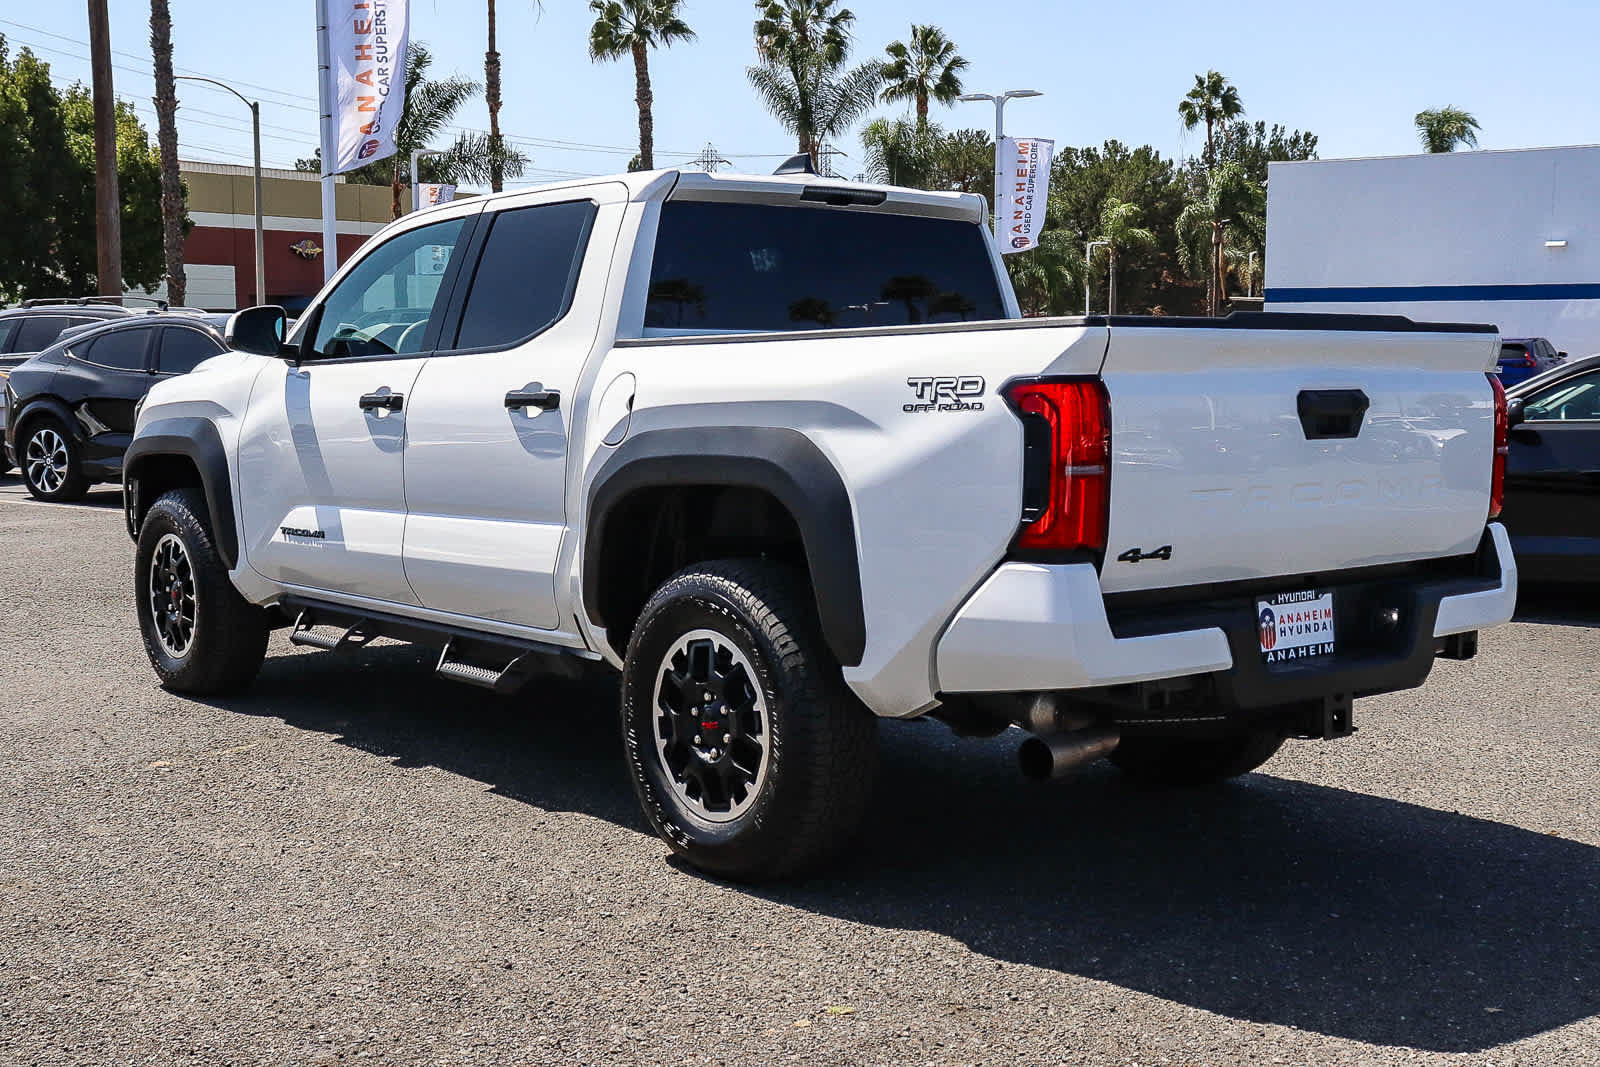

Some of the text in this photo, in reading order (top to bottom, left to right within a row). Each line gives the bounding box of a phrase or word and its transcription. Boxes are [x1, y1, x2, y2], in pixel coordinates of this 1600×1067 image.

[378, 67, 390, 97] CAR
[1012, 142, 1029, 233] ANAHEIM
[1024, 142, 1038, 234] USED CAR SUPERSTORE
[907, 376, 985, 404] TRD
[903, 402, 984, 413] OFF ROAD
[1278, 590, 1315, 603] HYUNDAI
[1279, 608, 1332, 625] ANAHEIM
[1280, 620, 1333, 637] HYUNDAI
[1267, 643, 1334, 663] ANAHEIM
